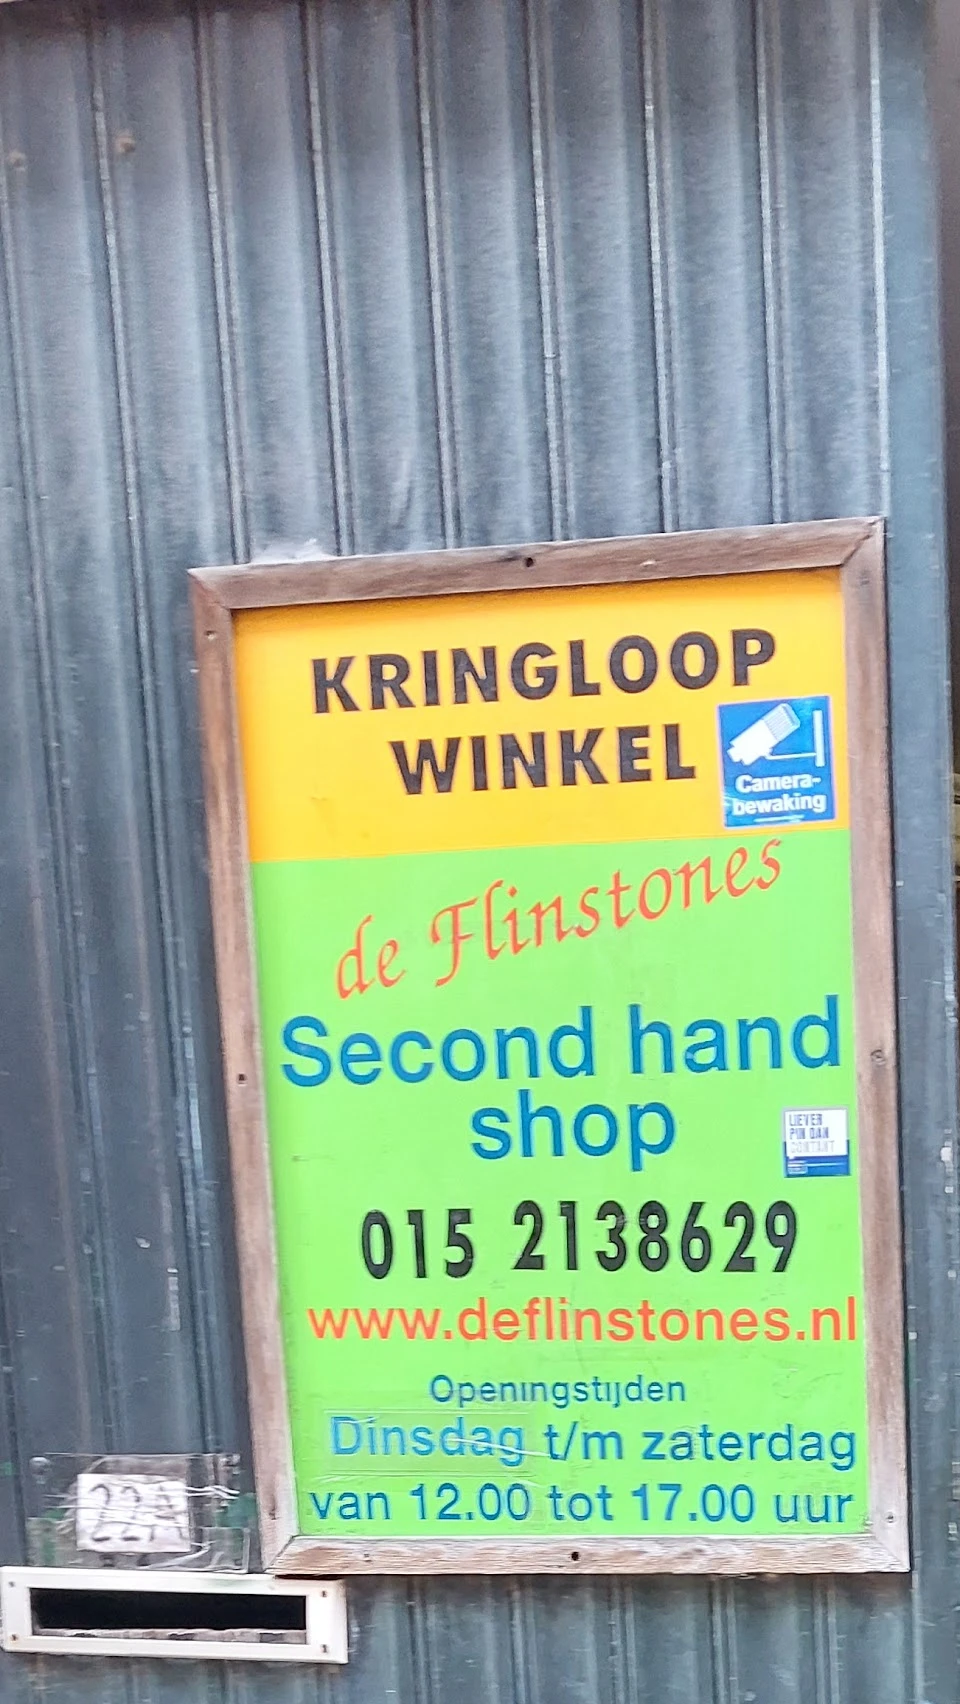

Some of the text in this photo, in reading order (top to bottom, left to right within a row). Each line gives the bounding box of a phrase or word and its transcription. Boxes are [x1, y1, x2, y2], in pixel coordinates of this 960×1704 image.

[313, 628, 776, 714] KRINGLOOP
[391, 723, 696, 795] WINKEL
[735, 773, 822, 793] Camera-
[731, 792, 827, 816] bewaking
[336, 838, 782, 1000] de Flinstones
[281, 994, 841, 1087] Second hand
[471, 1088, 677, 1172] shop
[361, 1200, 797, 1279] 015 2138629
[308, 1296, 857, 1342] www.deflinstones.nl
[429, 1374, 686, 1409] Openingstijden
[330, 1416, 857, 1472] Dinsdag t/m zaterdag
[308, 1482, 855, 1523] van 12.00 tot 17.00 uur
